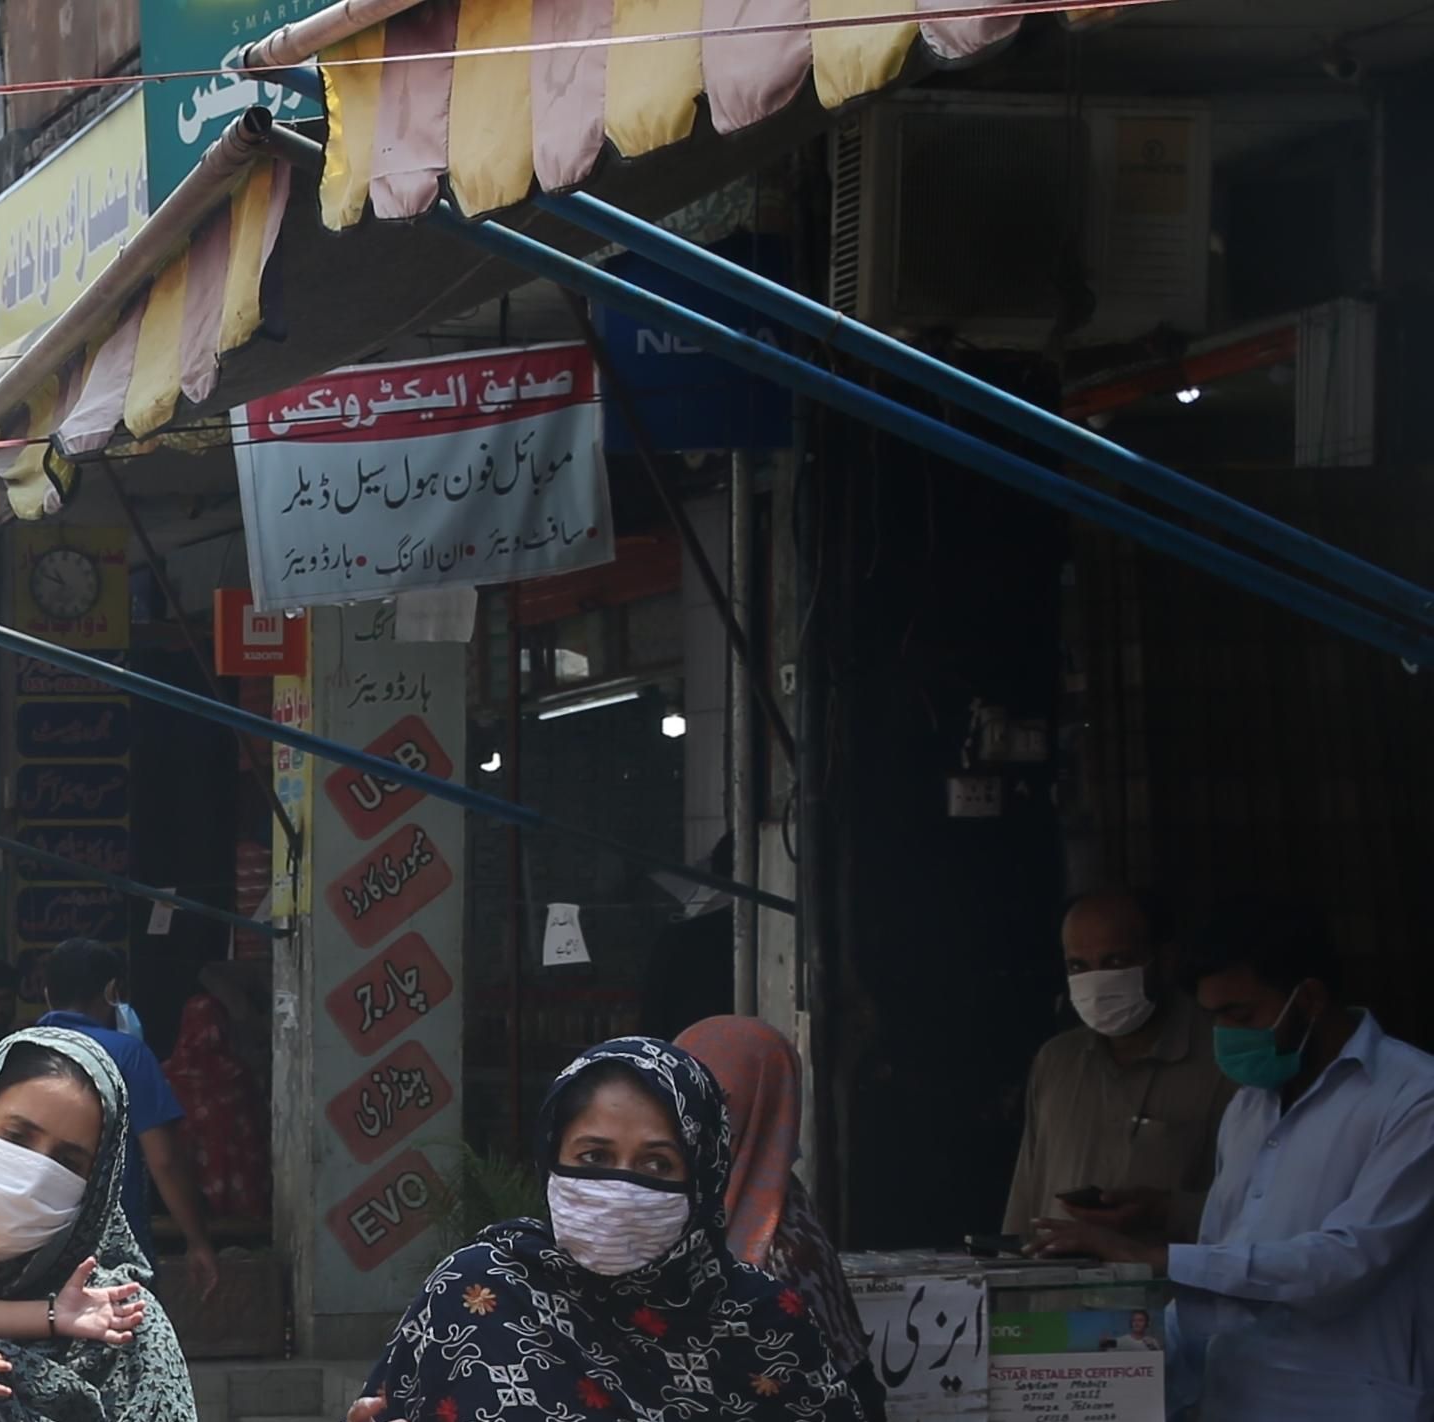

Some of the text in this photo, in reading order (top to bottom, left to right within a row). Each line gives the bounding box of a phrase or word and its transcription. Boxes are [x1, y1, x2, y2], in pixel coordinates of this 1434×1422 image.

[268, 369, 573, 435] صدیق الیکٹرونکس
[282, 431, 573, 514] موبائل فون ہول سیل ڈیلر
[344, 863, 383, 918] کارڈ
[355, 960, 428, 1033] چارجر
[347, 1170, 429, 1246] EVO
[881, 1285, 983, 1392] ایزی
[992, 1325, 1021, 1338] ong
[1030, 1367, 1082, 1381] RETAILER
[1083, 1366, 1154, 1380] CERTIFICATE
